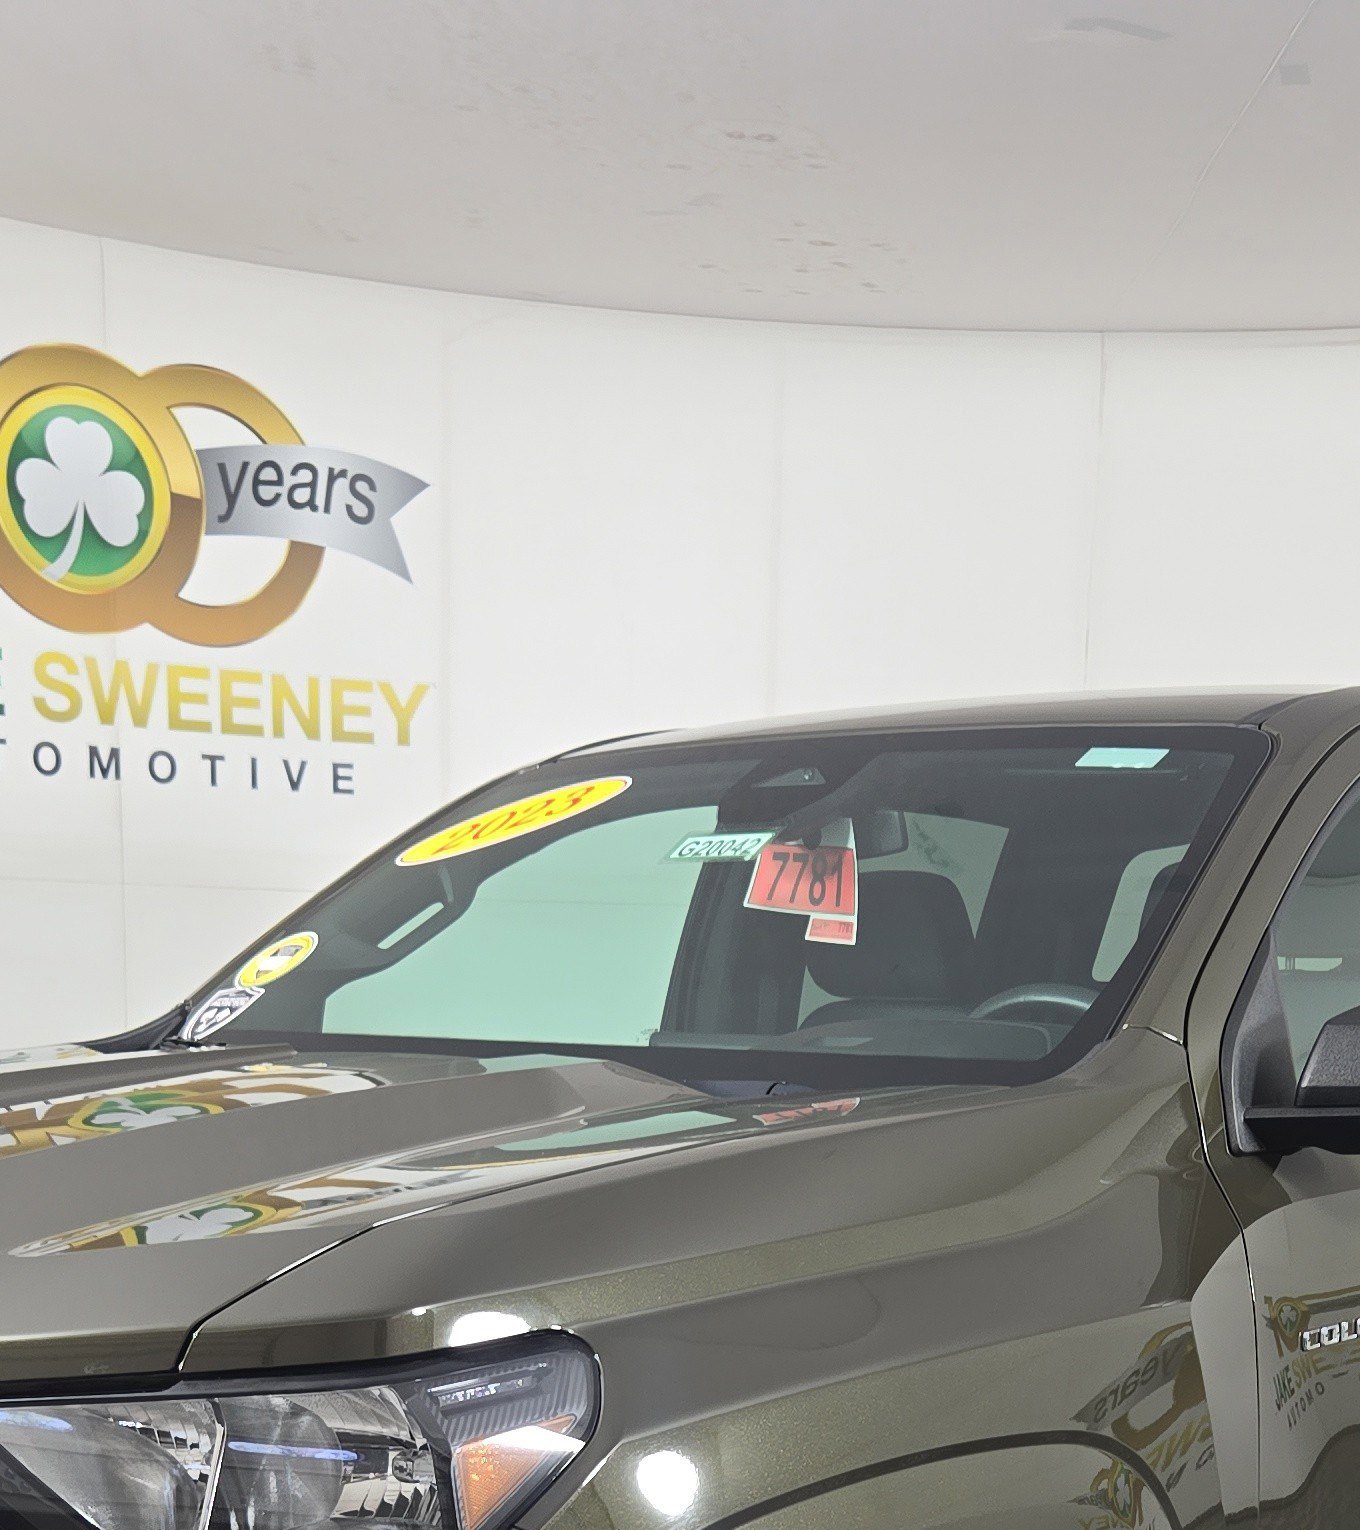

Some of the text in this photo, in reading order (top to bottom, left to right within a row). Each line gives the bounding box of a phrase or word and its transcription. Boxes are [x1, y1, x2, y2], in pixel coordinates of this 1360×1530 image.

[216, 458, 379, 525] years
[32, 650, 431, 747] SWEENEY
[431, 786, 595, 856] 2023
